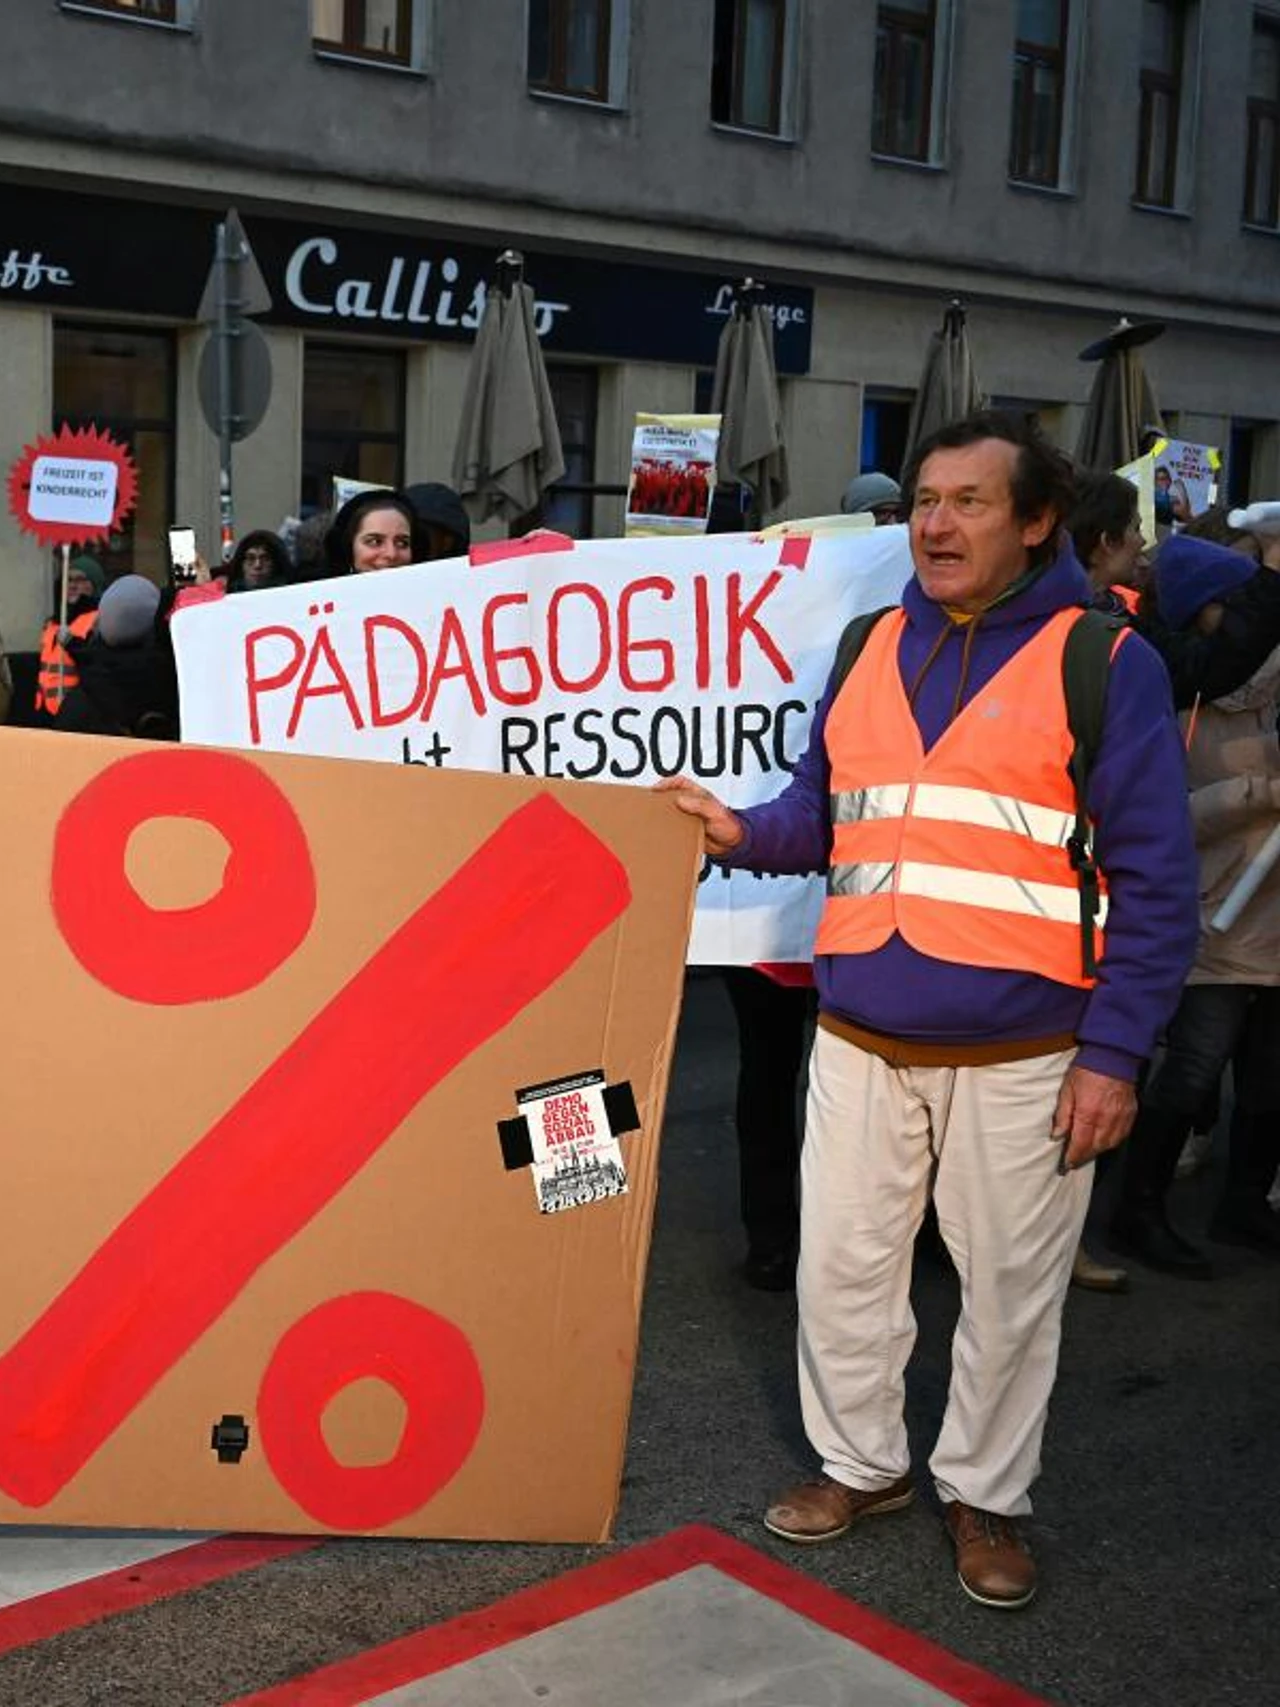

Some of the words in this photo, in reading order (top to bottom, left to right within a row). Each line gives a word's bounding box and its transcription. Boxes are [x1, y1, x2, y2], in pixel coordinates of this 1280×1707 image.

[285, 237, 569, 336] Calliso
[43, 467, 86, 479] FREIZEIT
[88, 471, 104, 481] IST
[36, 484, 108, 499] KINDERRECHT
[245, 570, 794, 745] PÄDAGOGIK
[501, 699, 821, 778] RESSOURC
[542, 1102, 589, 1123] GEGEN
[544, 1092, 582, 1112] DEMO
[542, 1114, 592, 1135] SOZIAL
[546, 1121, 597, 1148] ABBAU
